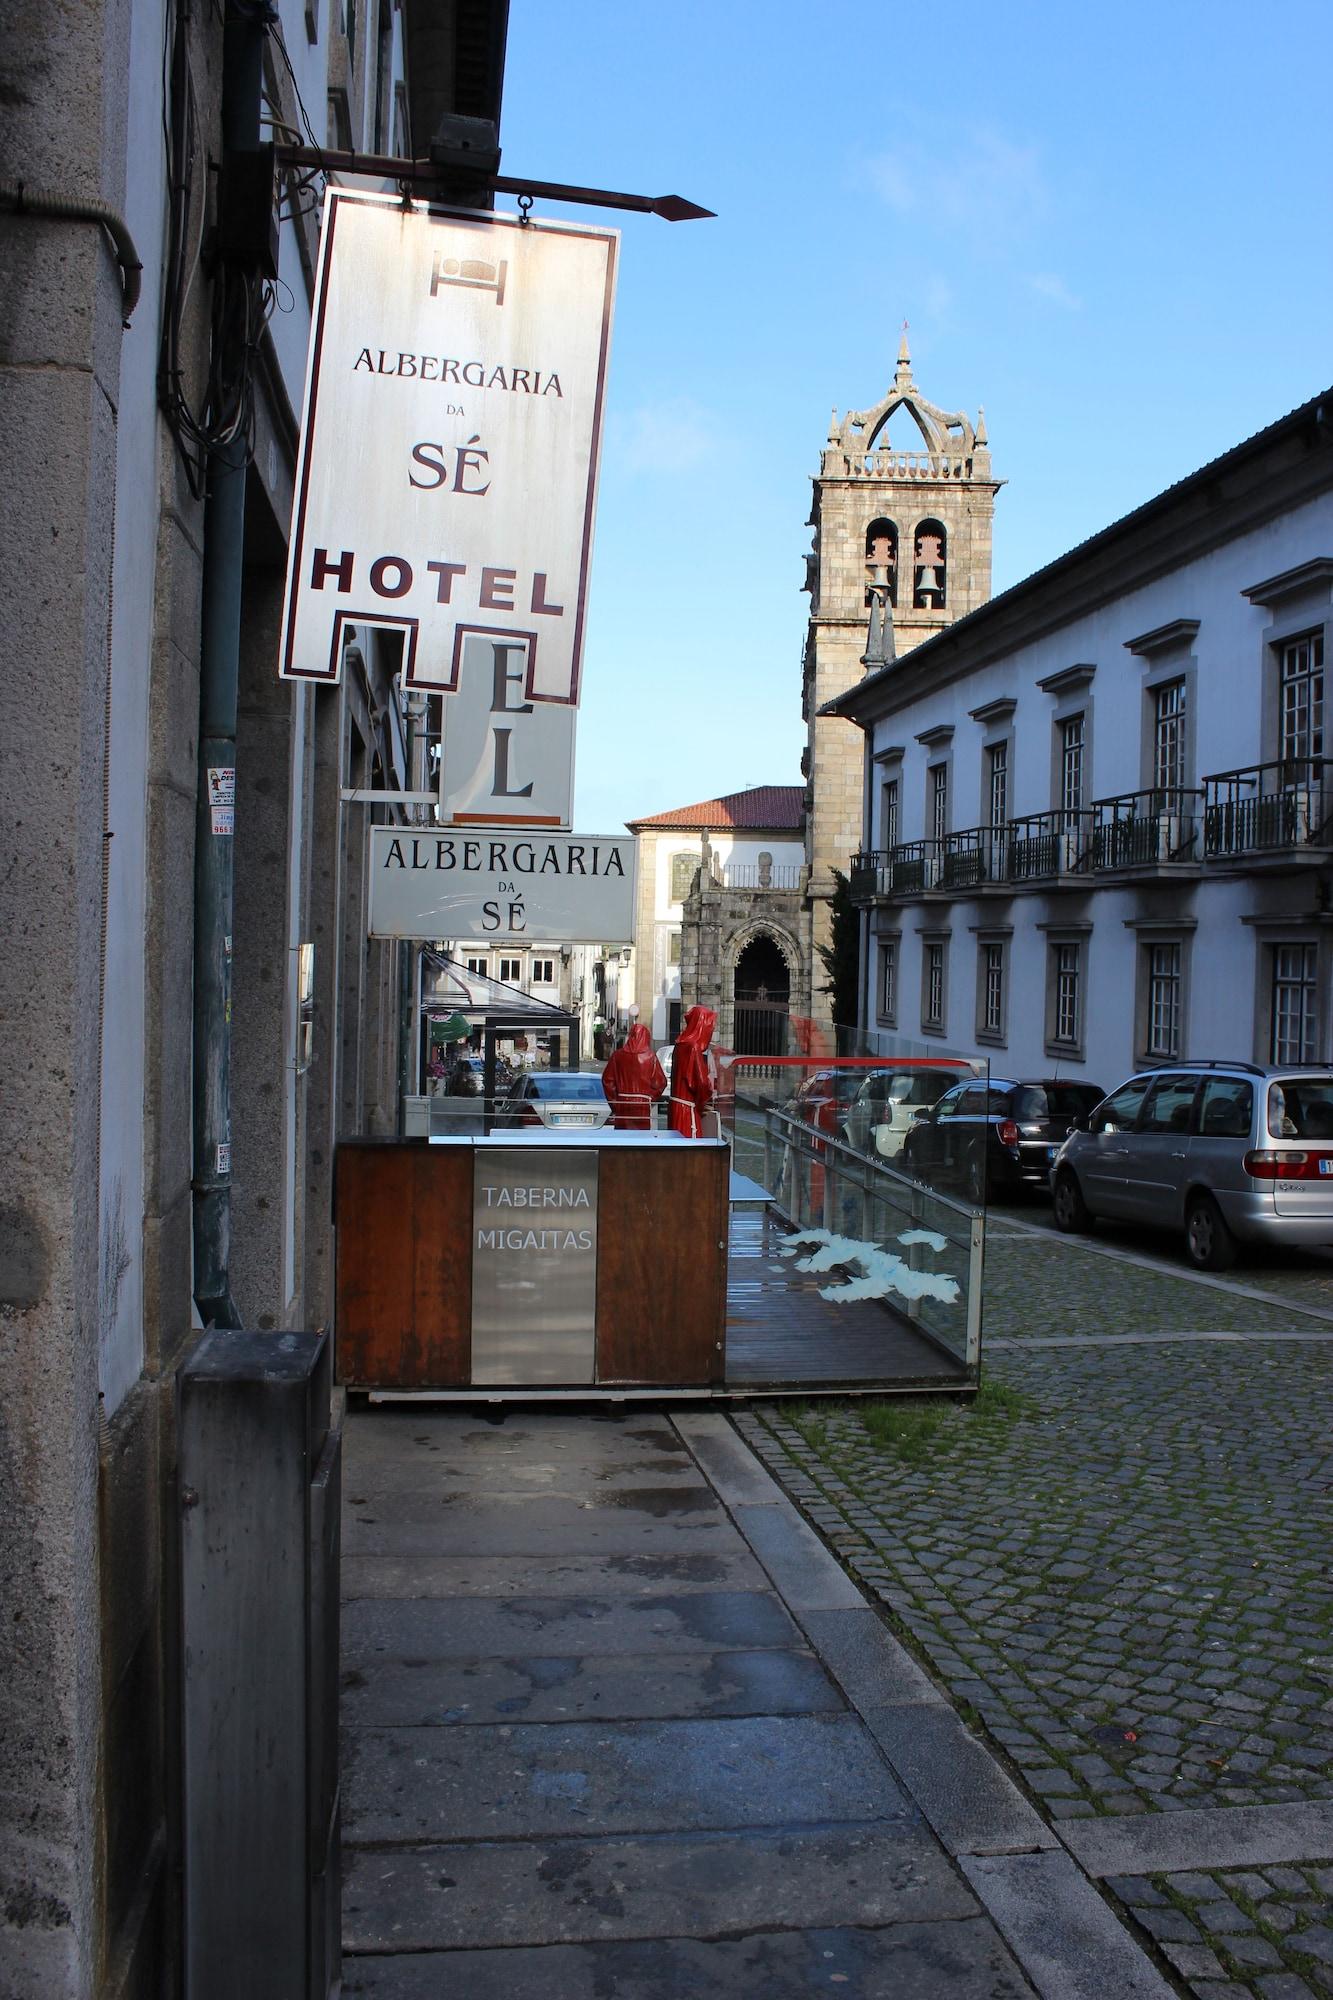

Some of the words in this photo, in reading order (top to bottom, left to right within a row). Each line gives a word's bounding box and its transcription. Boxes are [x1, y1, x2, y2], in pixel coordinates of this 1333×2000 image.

[352, 348, 564, 398] ALBERGARIA
[447, 404, 465, 417] DA
[408, 435, 492, 497] SÉ
[310, 548, 565, 616] HOTEL
[384, 839, 626, 877] ALBERGARIA
[498, 881, 516, 893] DA
[481, 893, 527, 932] SÉ
[482, 1187, 590, 1208] TABERNA
[477, 1230, 592, 1251] MIGAITAS
